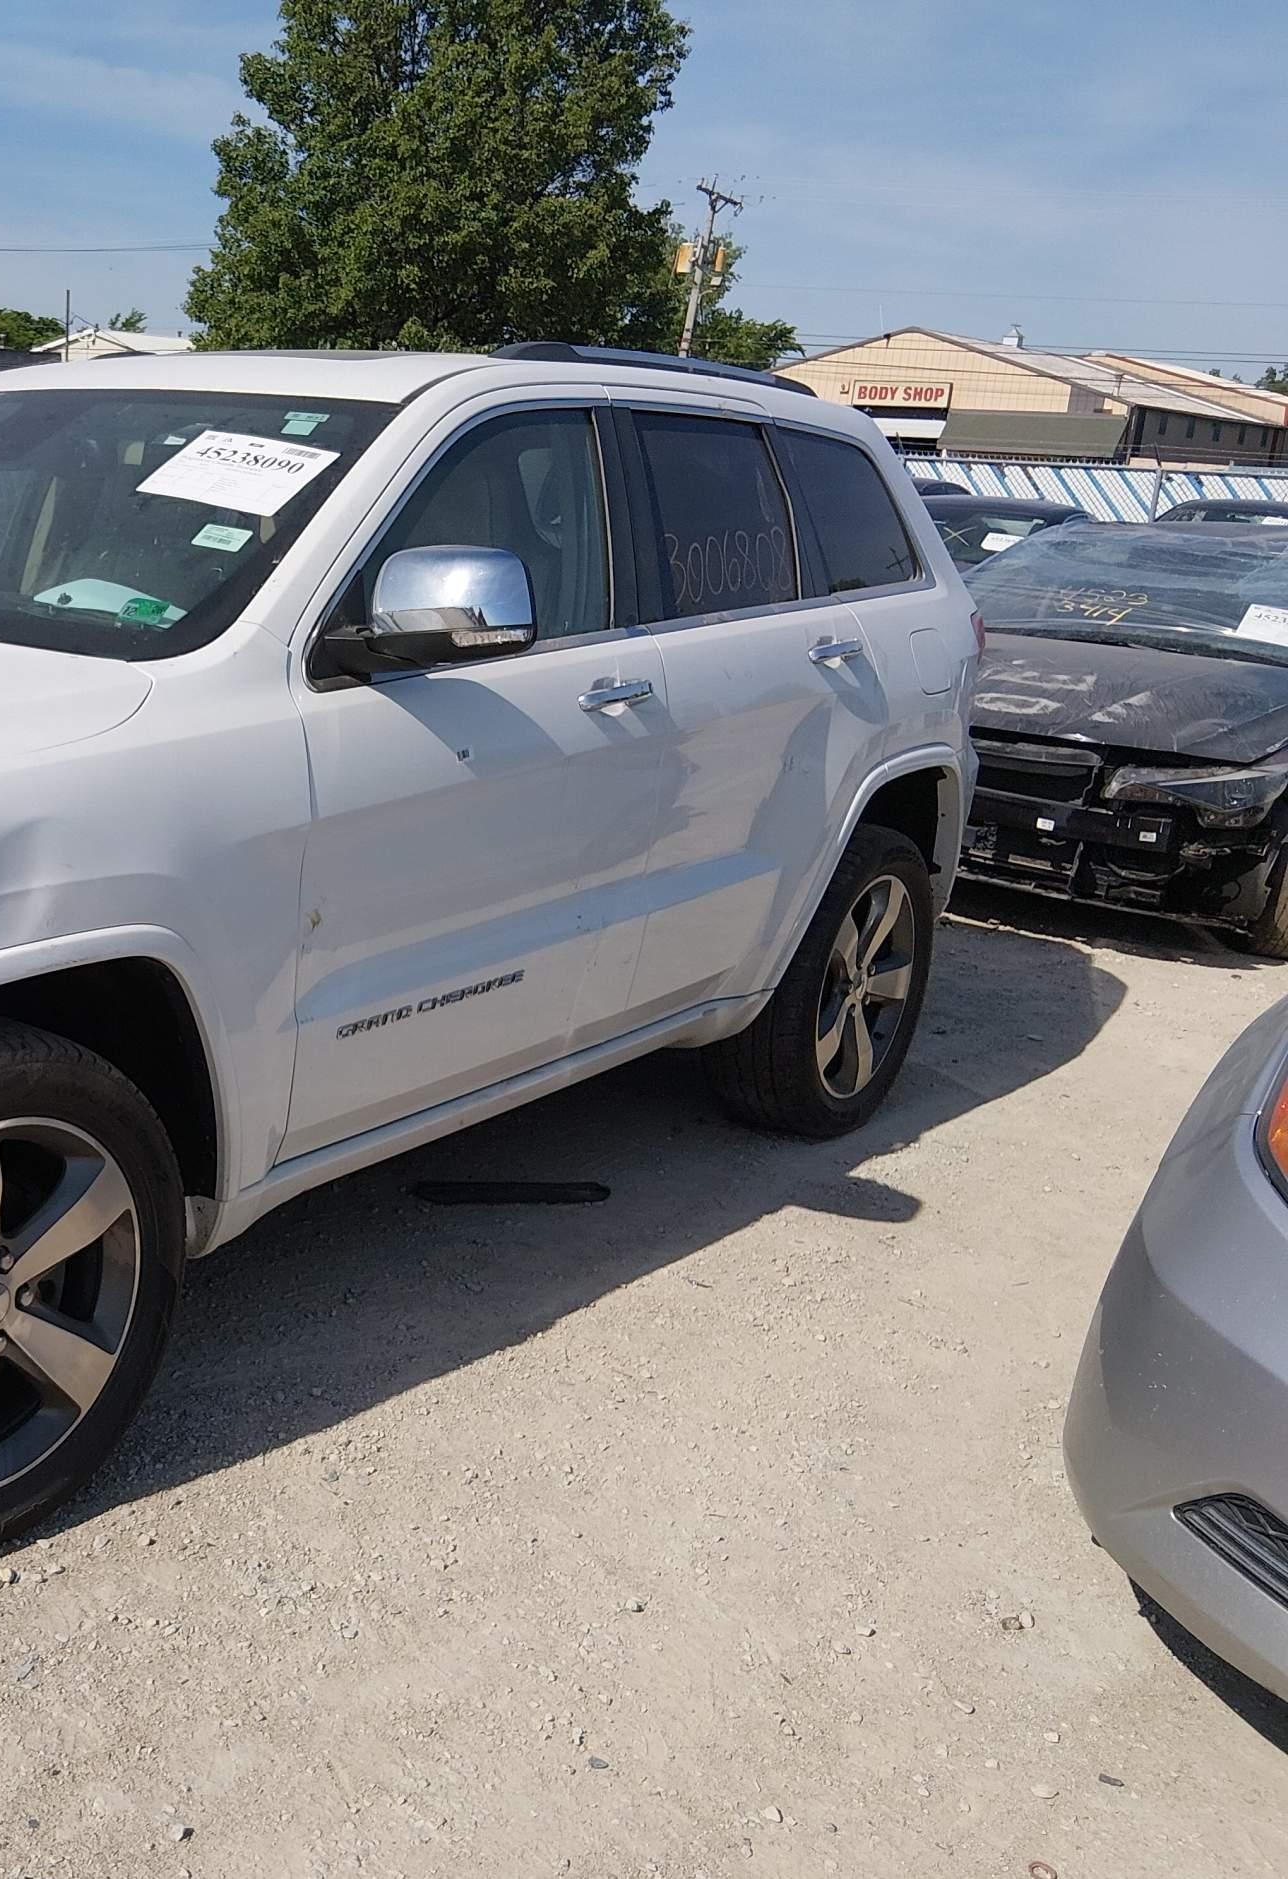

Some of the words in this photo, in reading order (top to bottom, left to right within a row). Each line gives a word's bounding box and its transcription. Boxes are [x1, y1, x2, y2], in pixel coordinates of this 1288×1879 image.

[857, 385, 899, 400] BODY
[902, 386, 945, 402] SHOP
[196, 446, 305, 475] 45238090
[336, 1004, 413, 1041] GRAND
[416, 969, 526, 1014] CHEROKEE
